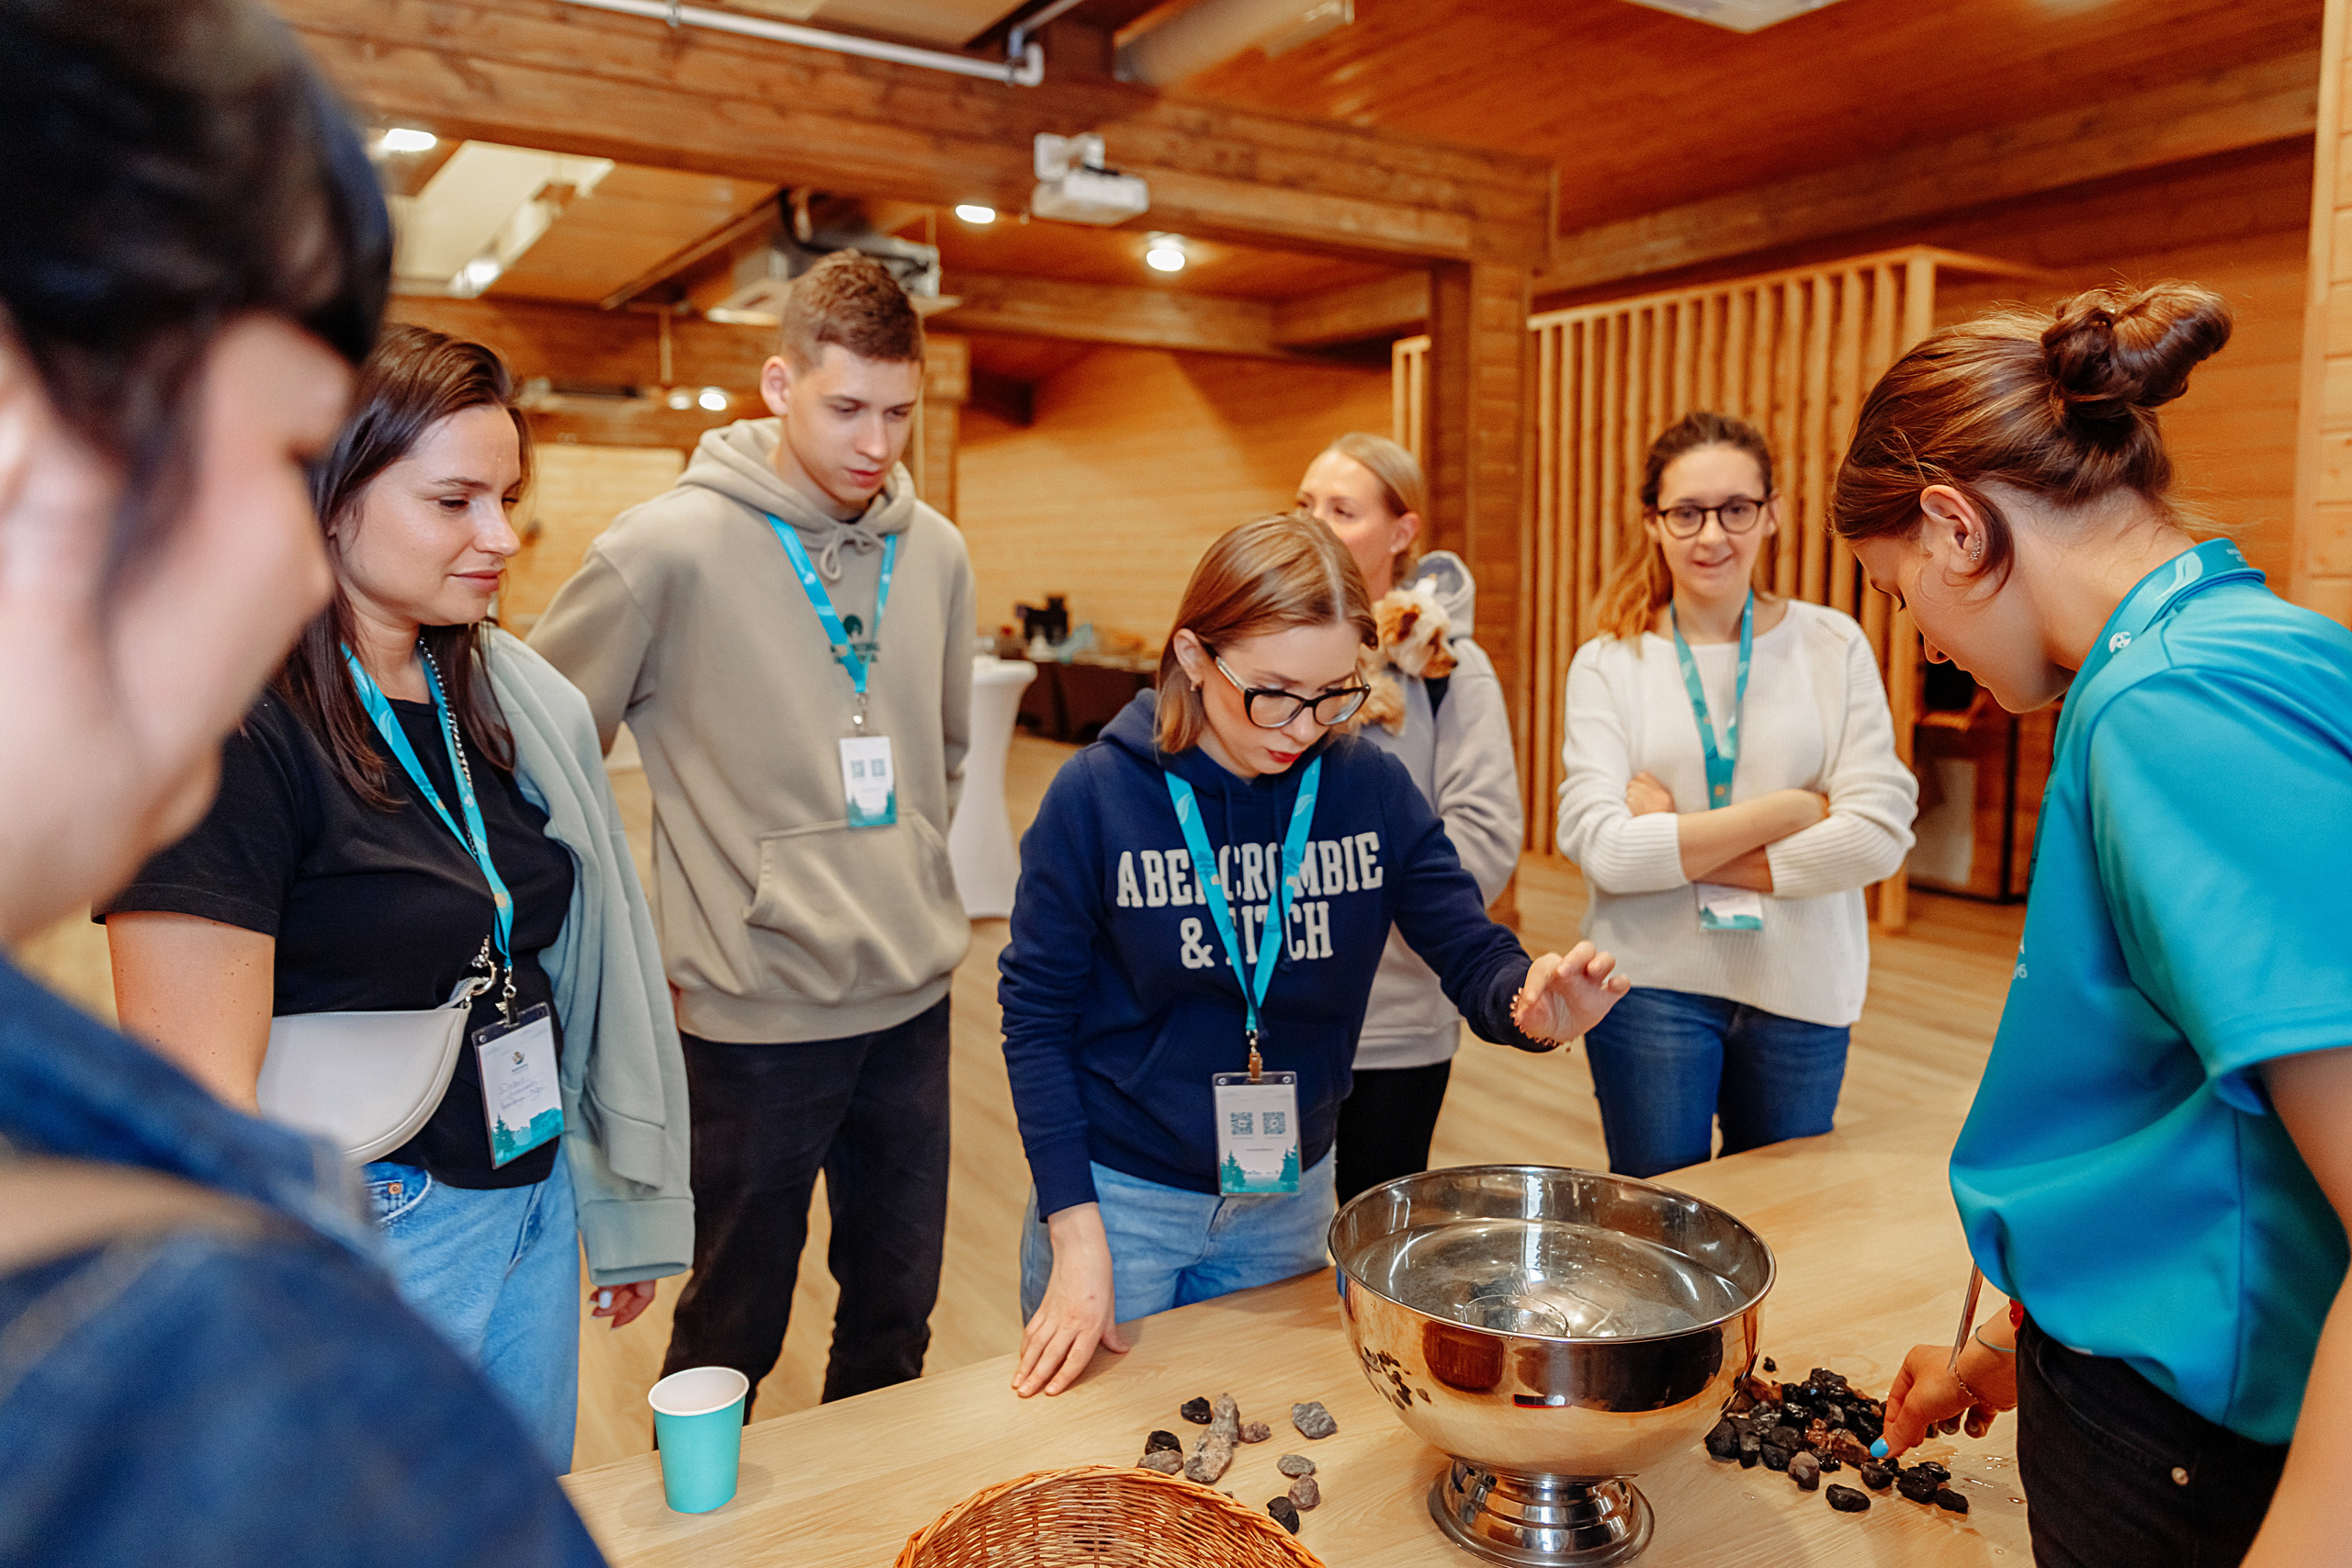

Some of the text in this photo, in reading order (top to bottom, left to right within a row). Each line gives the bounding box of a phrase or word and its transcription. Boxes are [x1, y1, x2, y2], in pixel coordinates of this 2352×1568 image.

[1116, 831, 1384, 908] ABECRMBIE
[1180, 900, 1334, 969] & ICH
